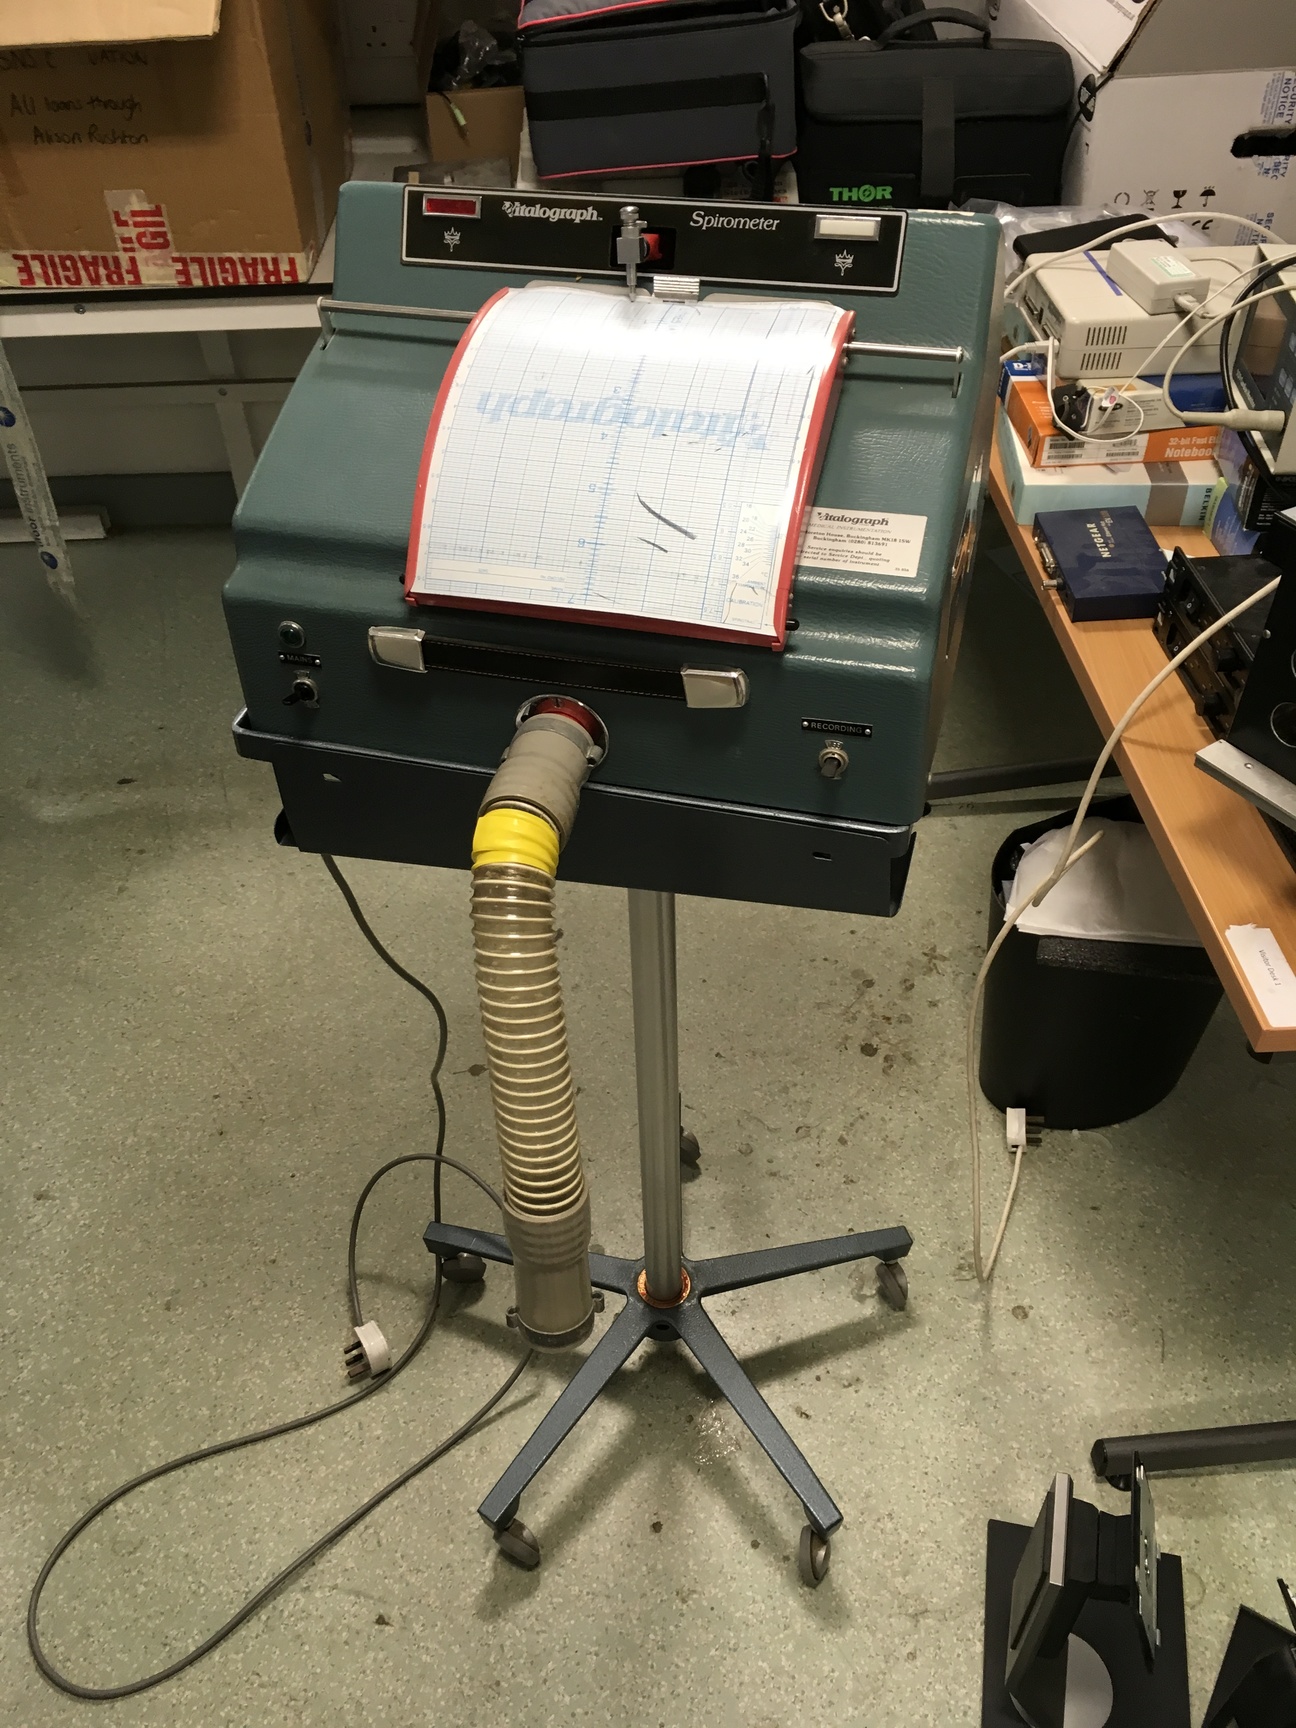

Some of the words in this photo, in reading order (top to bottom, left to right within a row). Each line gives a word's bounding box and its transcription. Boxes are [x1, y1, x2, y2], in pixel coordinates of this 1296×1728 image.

[1275, 77, 1292, 119] NOTICE
[829, 184, 893, 203] THOR
[501, 201, 599, 223] Vitalograph
[690, 210, 780, 231] Spirometer
[12, 253, 142, 286] FRAGILE
[171, 255, 299, 286] FRAGILE
[476, 388, 770, 452] Vitalograph
[1168, 437, 1191, 446] 32-bit
[1192, 436, 1208, 445] Fast
[1164, 447, 1214, 458] Noteboo
[6, 444, 34, 513] instruments
[1199, 488, 1212, 521] BELKIN
[817, 512, 889, 526] Vitalograph
[836, 525, 892, 534] INSTRUMENTATION
[1087, 523, 1112, 558] NETGEAR
[727, 598, 763, 608] CALIBRATION
[286, 654, 313, 664] MAINS
[811, 722, 862, 734] RECORDING
[1258, 949, 1271, 967] Visitor
[1267, 967, 1279, 981] Desk
